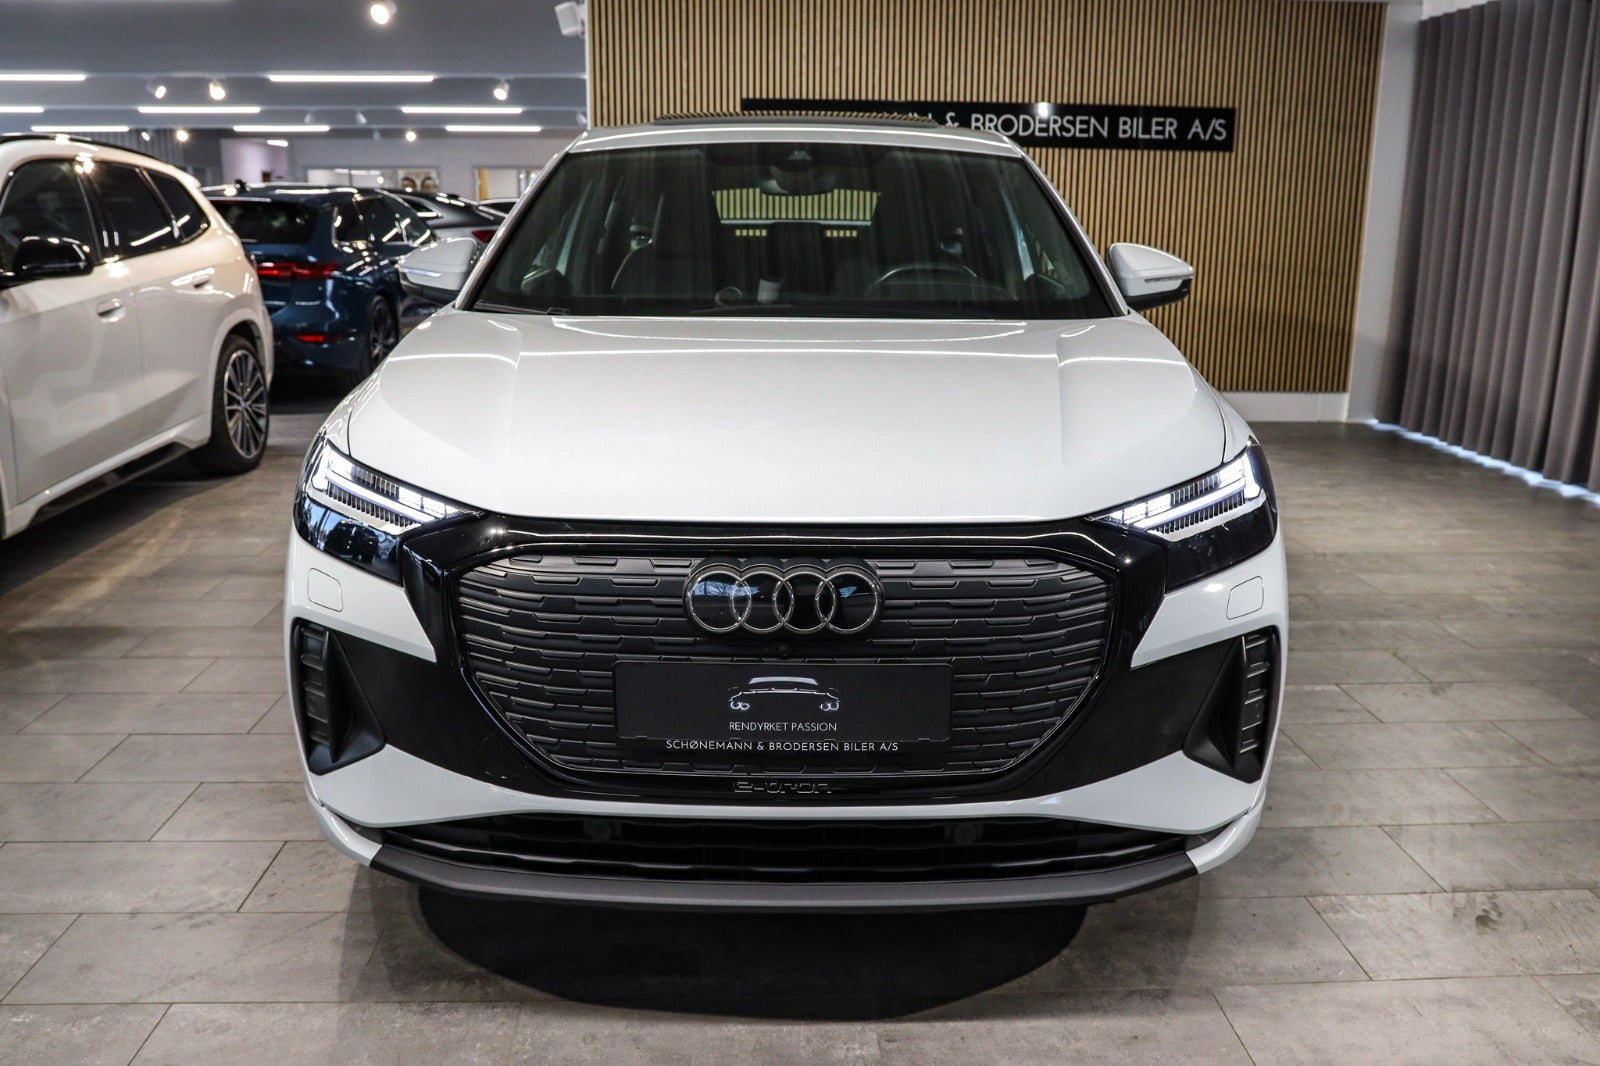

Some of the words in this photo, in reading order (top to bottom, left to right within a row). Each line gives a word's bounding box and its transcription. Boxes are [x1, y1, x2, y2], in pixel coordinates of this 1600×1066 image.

[945, 113, 960, 128] &
[971, 113, 1109, 139] BRODERSEN
[1118, 116, 1178, 140] BILER
[1188, 119, 1227, 141] A/S
[729, 721, 788, 732] RENDYRKET
[791, 722, 837, 732] PASSION
[665, 739, 752, 751] SCHØNEMANN
[757, 741, 764, 751] &
[768, 741, 839, 752] BRODERSEN
[843, 742, 876, 752] BILER
[879, 742, 899, 752] A/S
